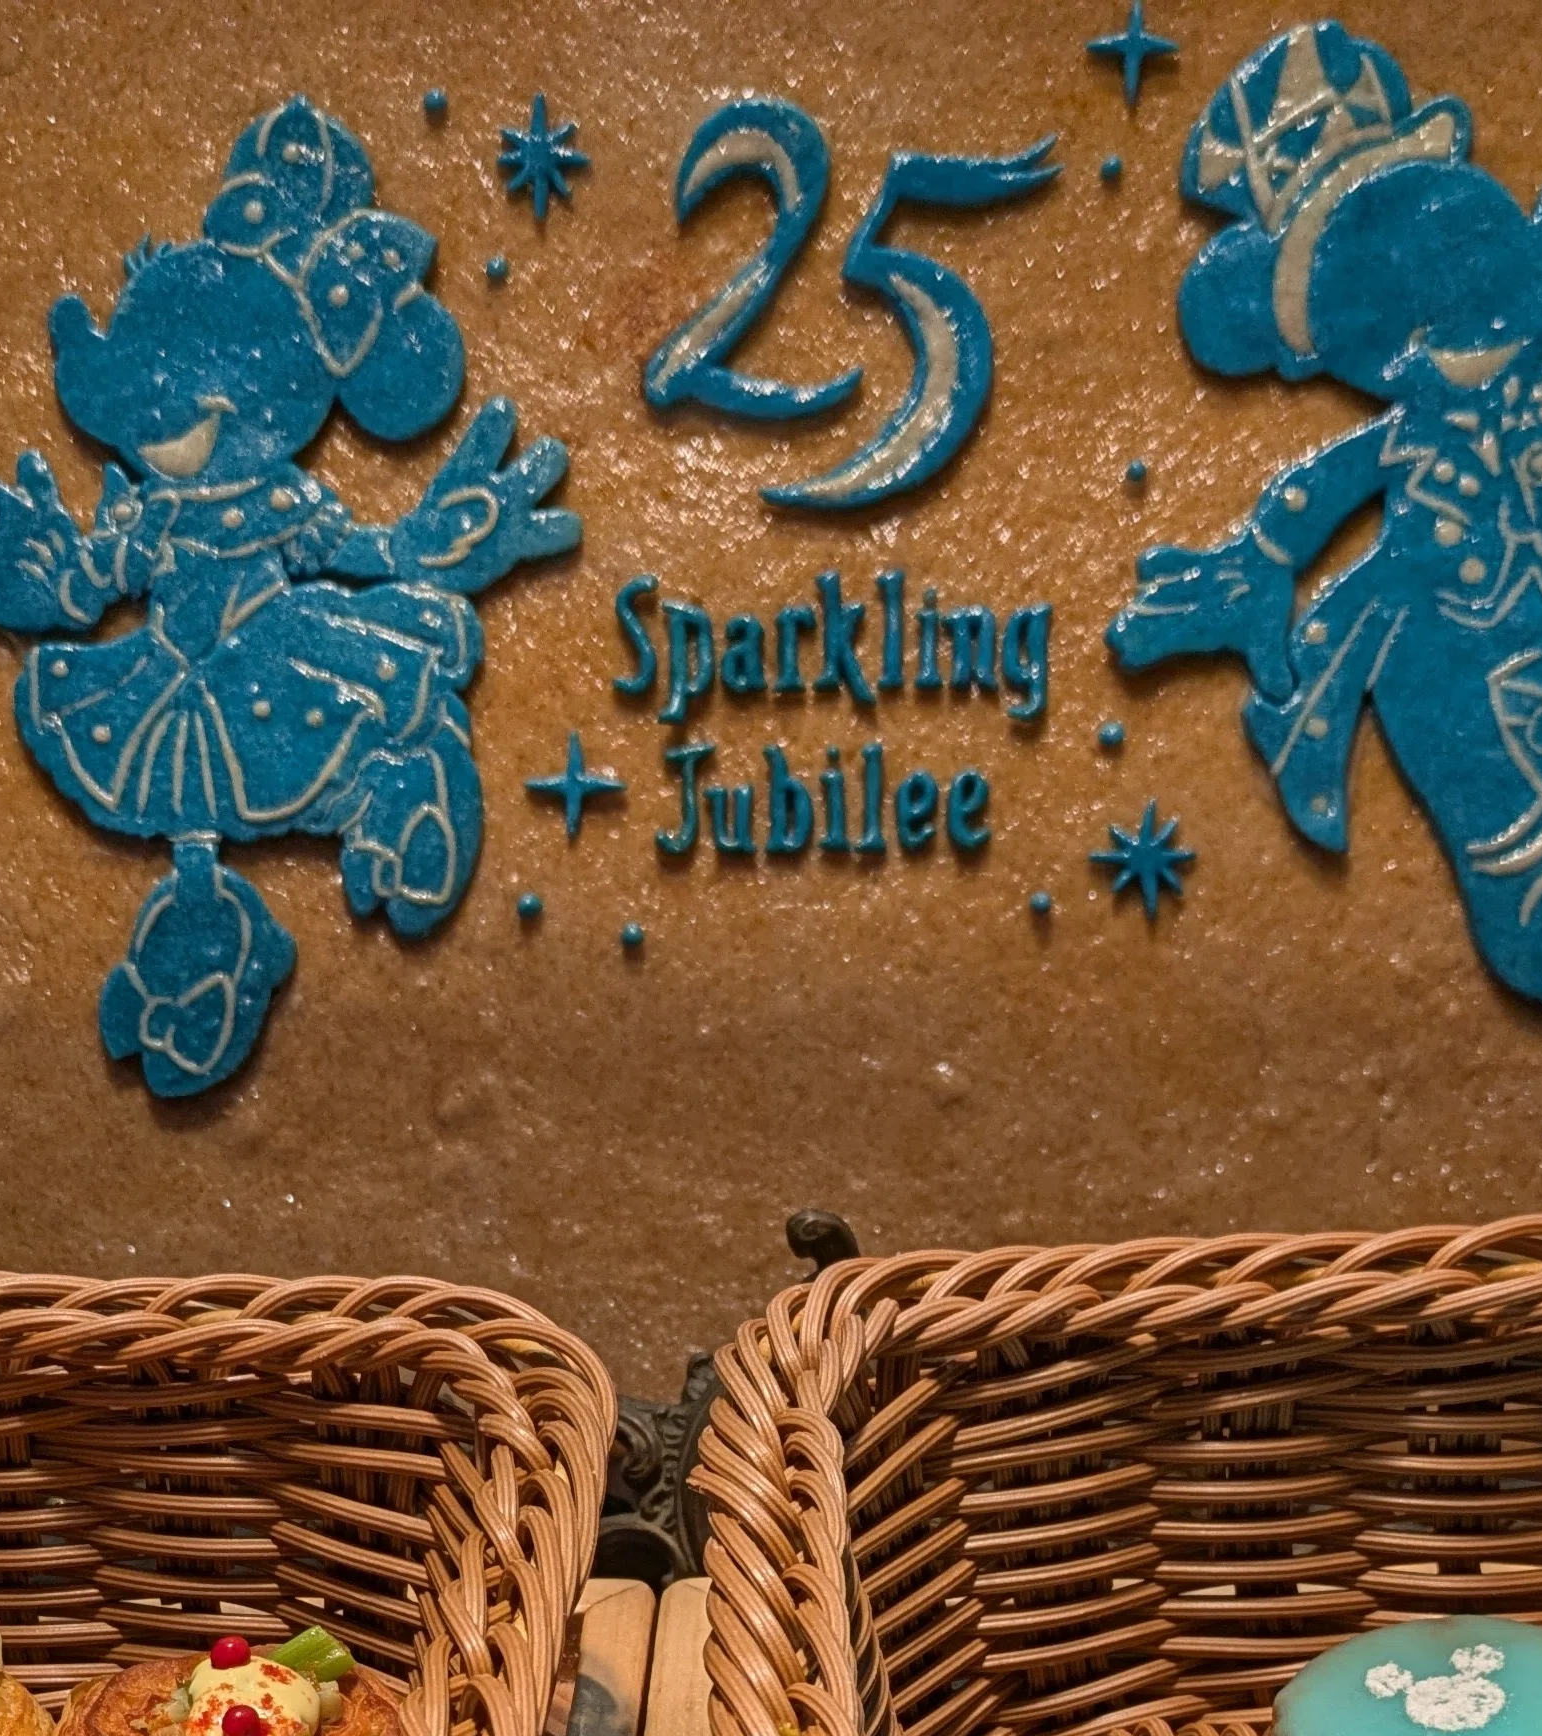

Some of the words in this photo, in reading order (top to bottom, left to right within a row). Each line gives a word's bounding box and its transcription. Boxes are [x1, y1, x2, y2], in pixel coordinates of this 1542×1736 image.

[646, 98, 1063, 510] 25
[612, 570, 1052, 722] Sparkling
[657, 742, 993, 856] Jubilee
